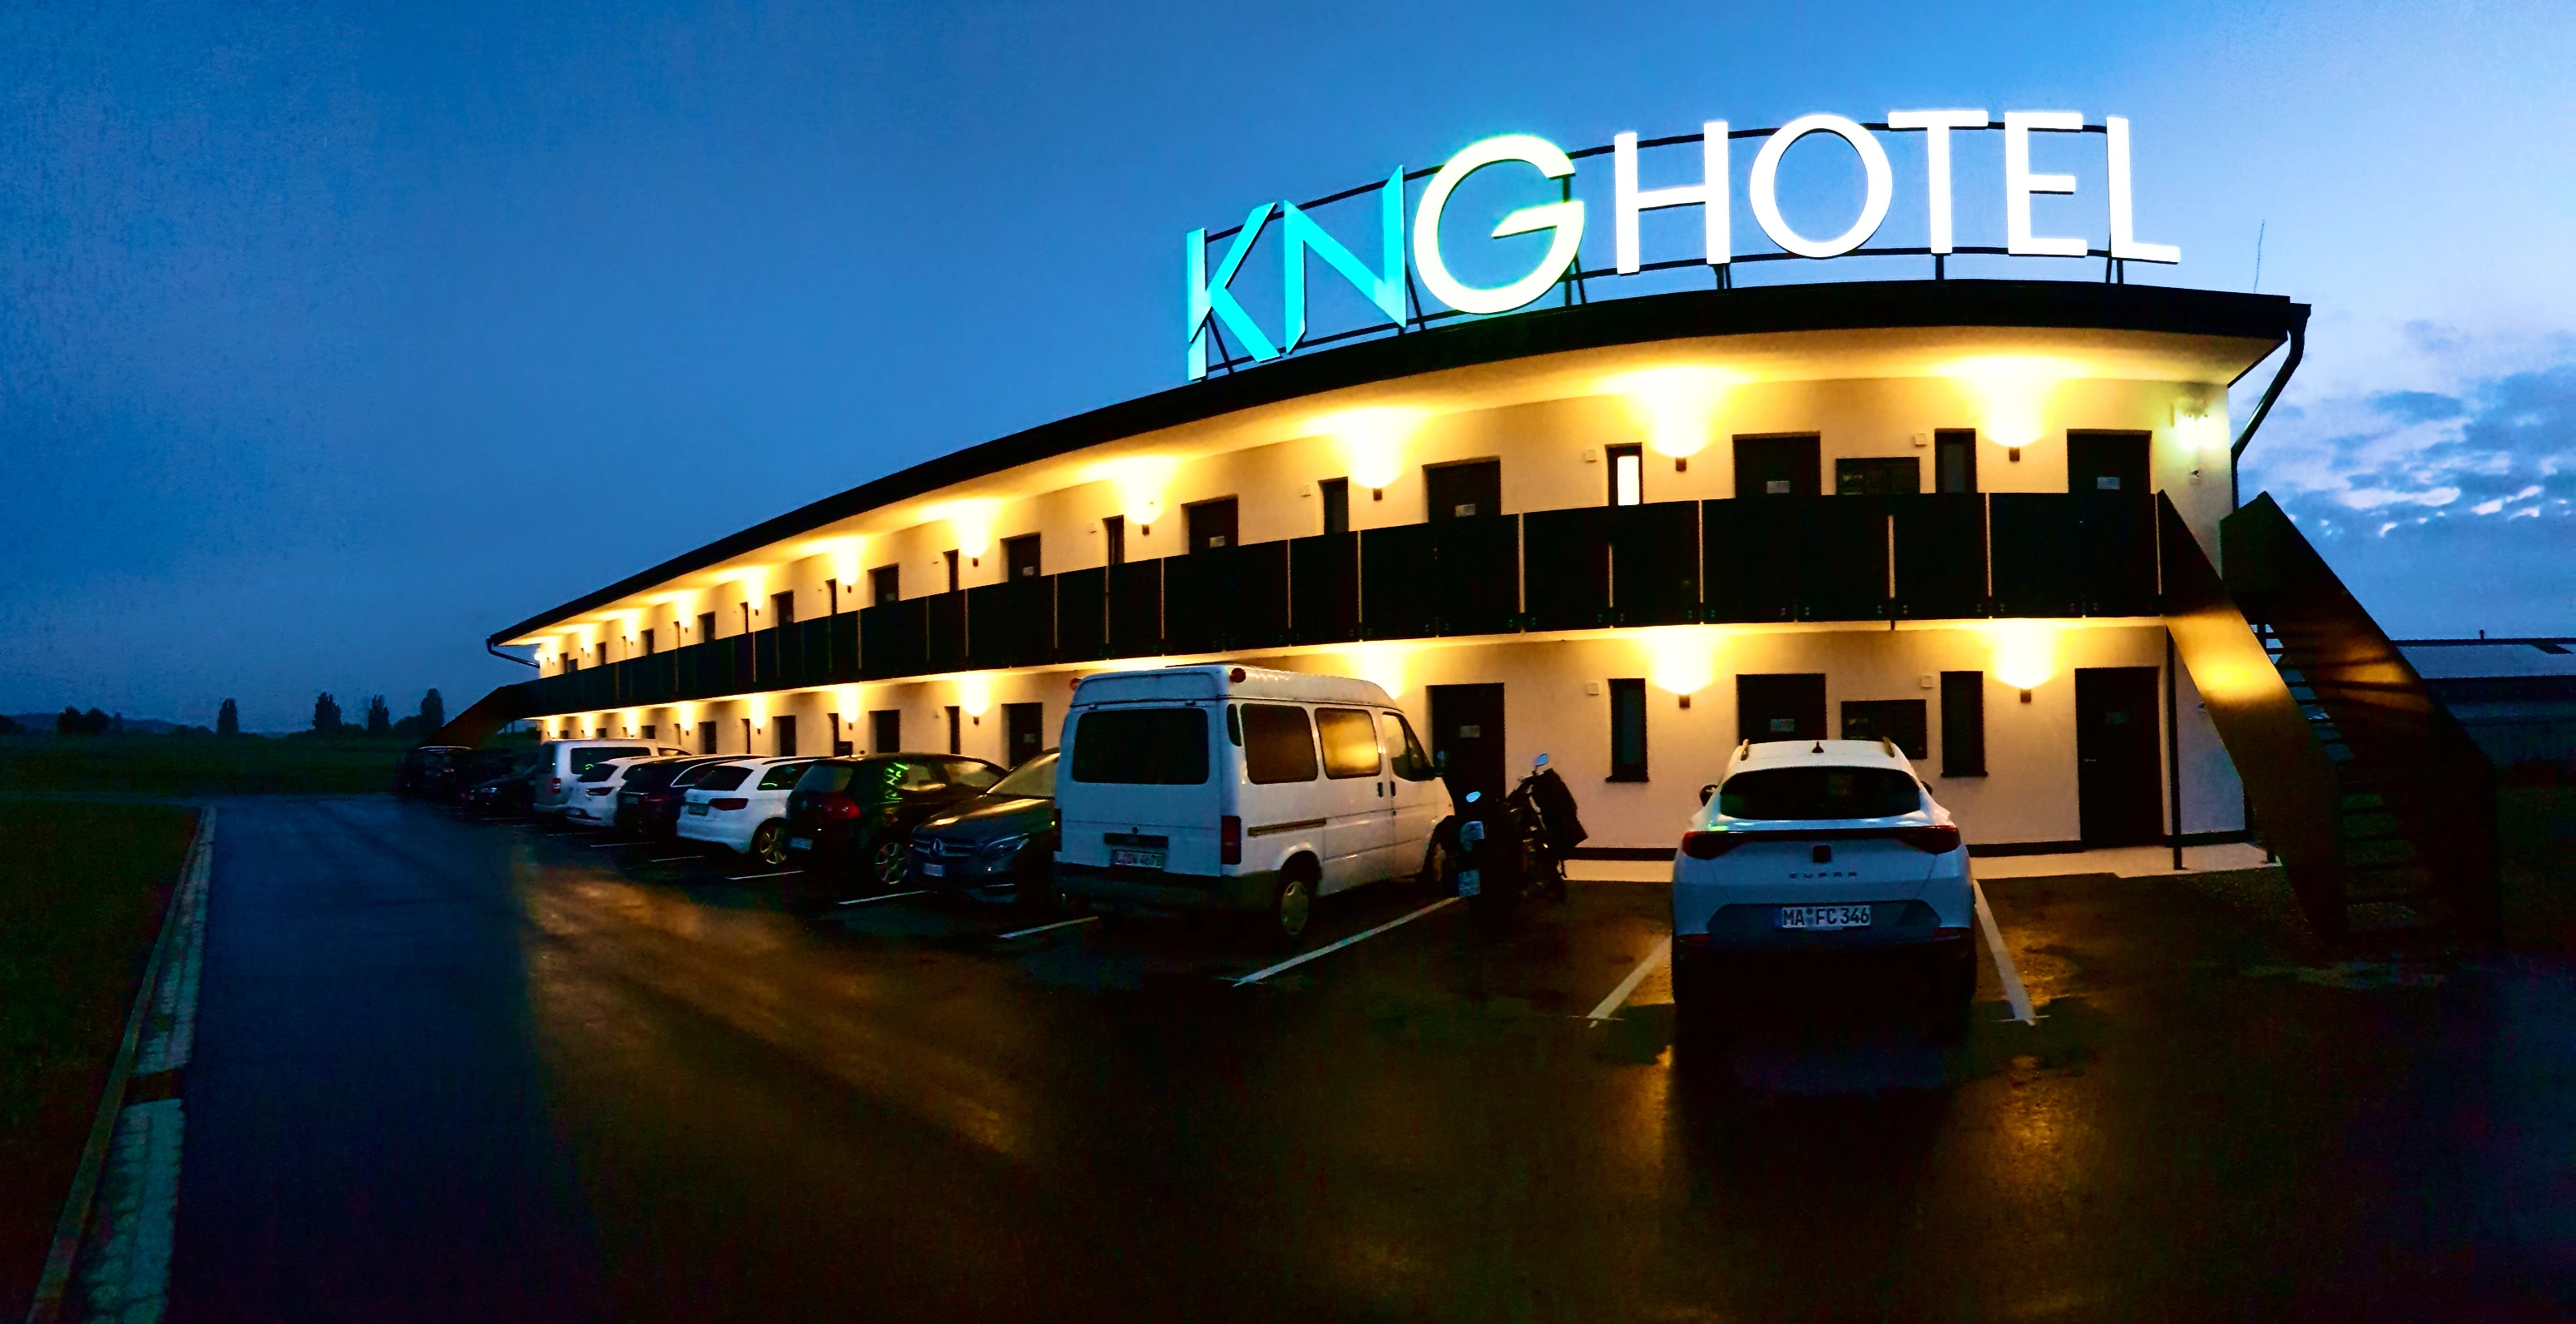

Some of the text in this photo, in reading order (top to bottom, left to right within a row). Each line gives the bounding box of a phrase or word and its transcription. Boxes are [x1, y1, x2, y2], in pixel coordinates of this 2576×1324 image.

[1186, 110, 2182, 381] KNG HOTEL
[1783, 908, 1805, 926] MA
